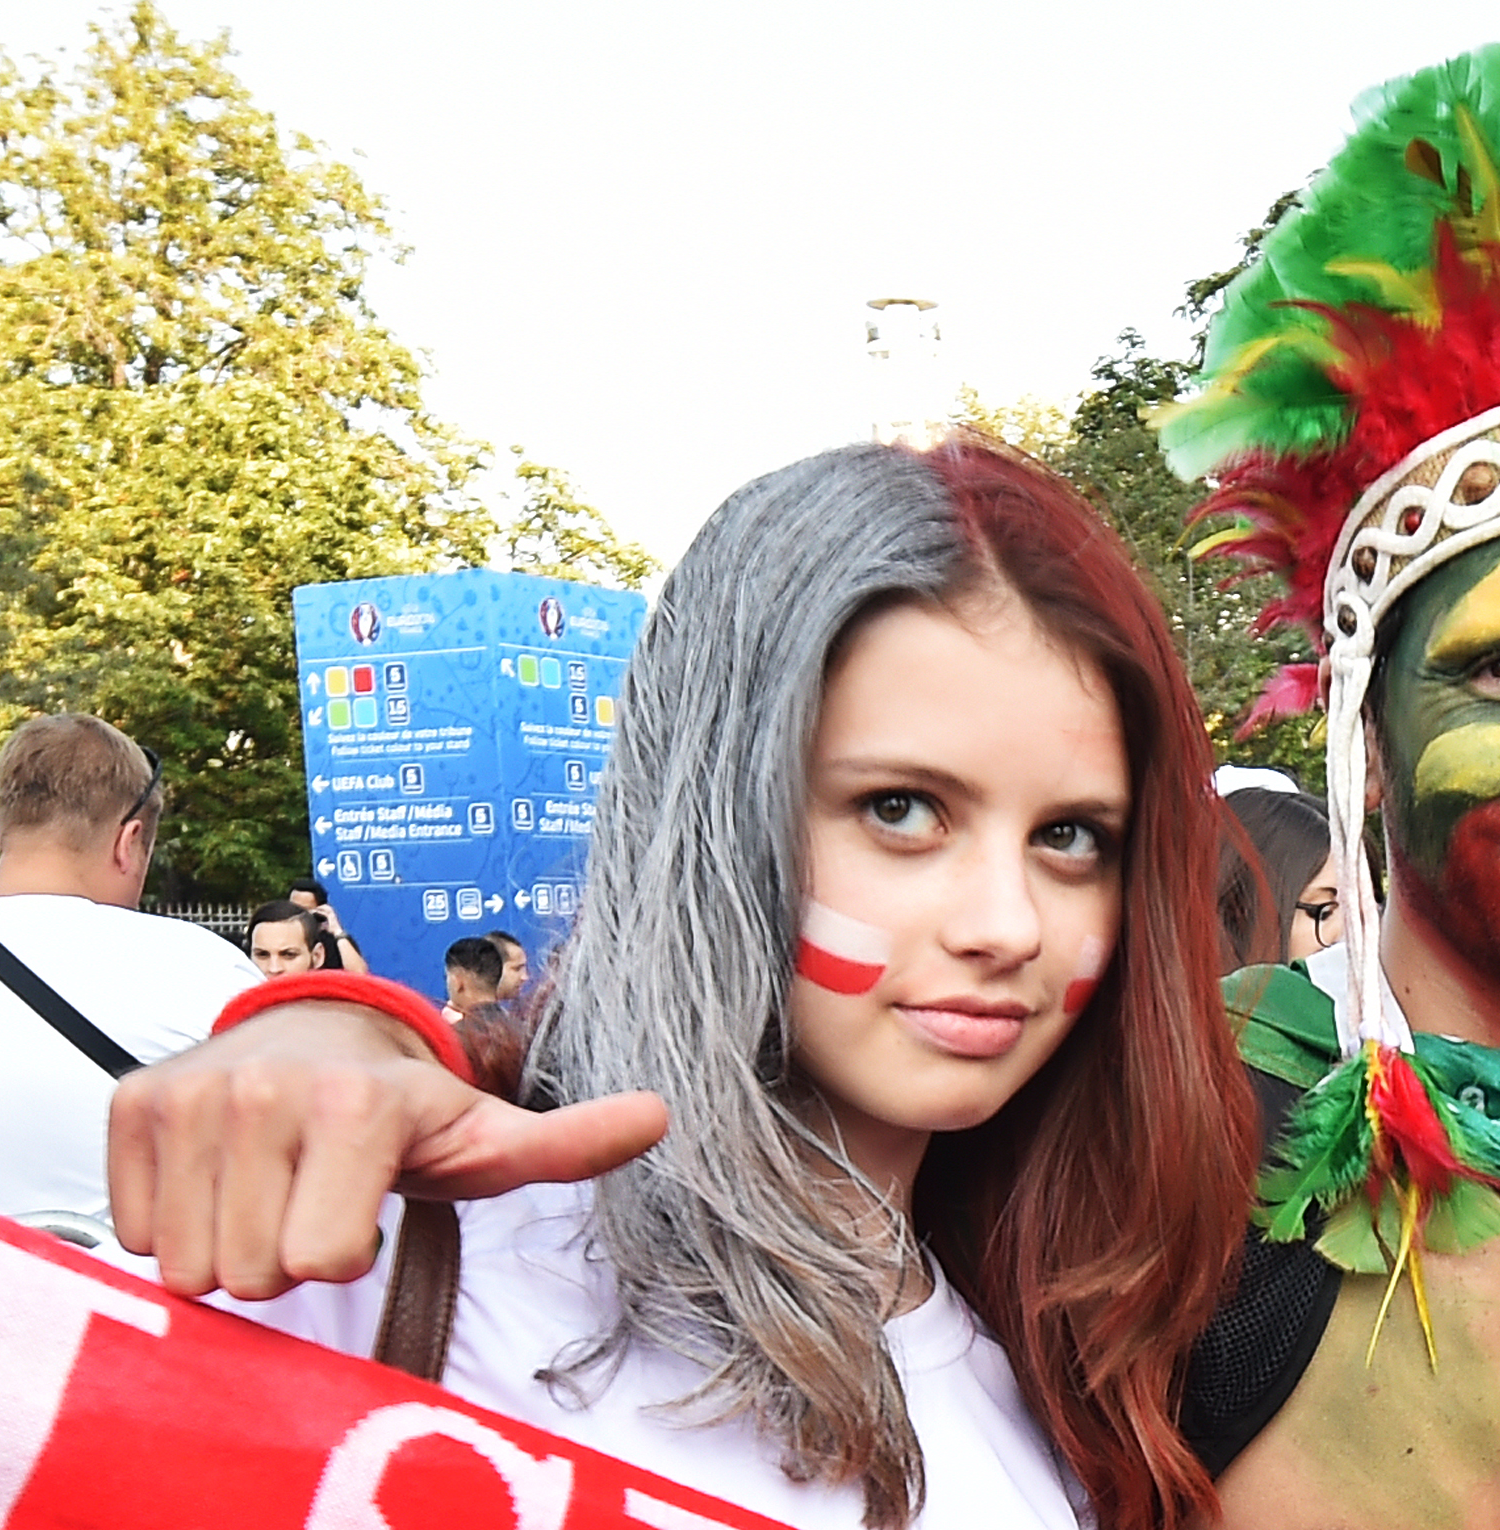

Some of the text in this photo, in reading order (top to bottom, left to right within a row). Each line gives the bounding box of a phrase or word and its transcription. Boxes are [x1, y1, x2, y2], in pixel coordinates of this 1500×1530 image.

[332, 776, 364, 791] UEFA
[366, 774, 395, 789] Club
[334, 806, 375, 822] Entrée
[408, 823, 462, 838] Entrance
